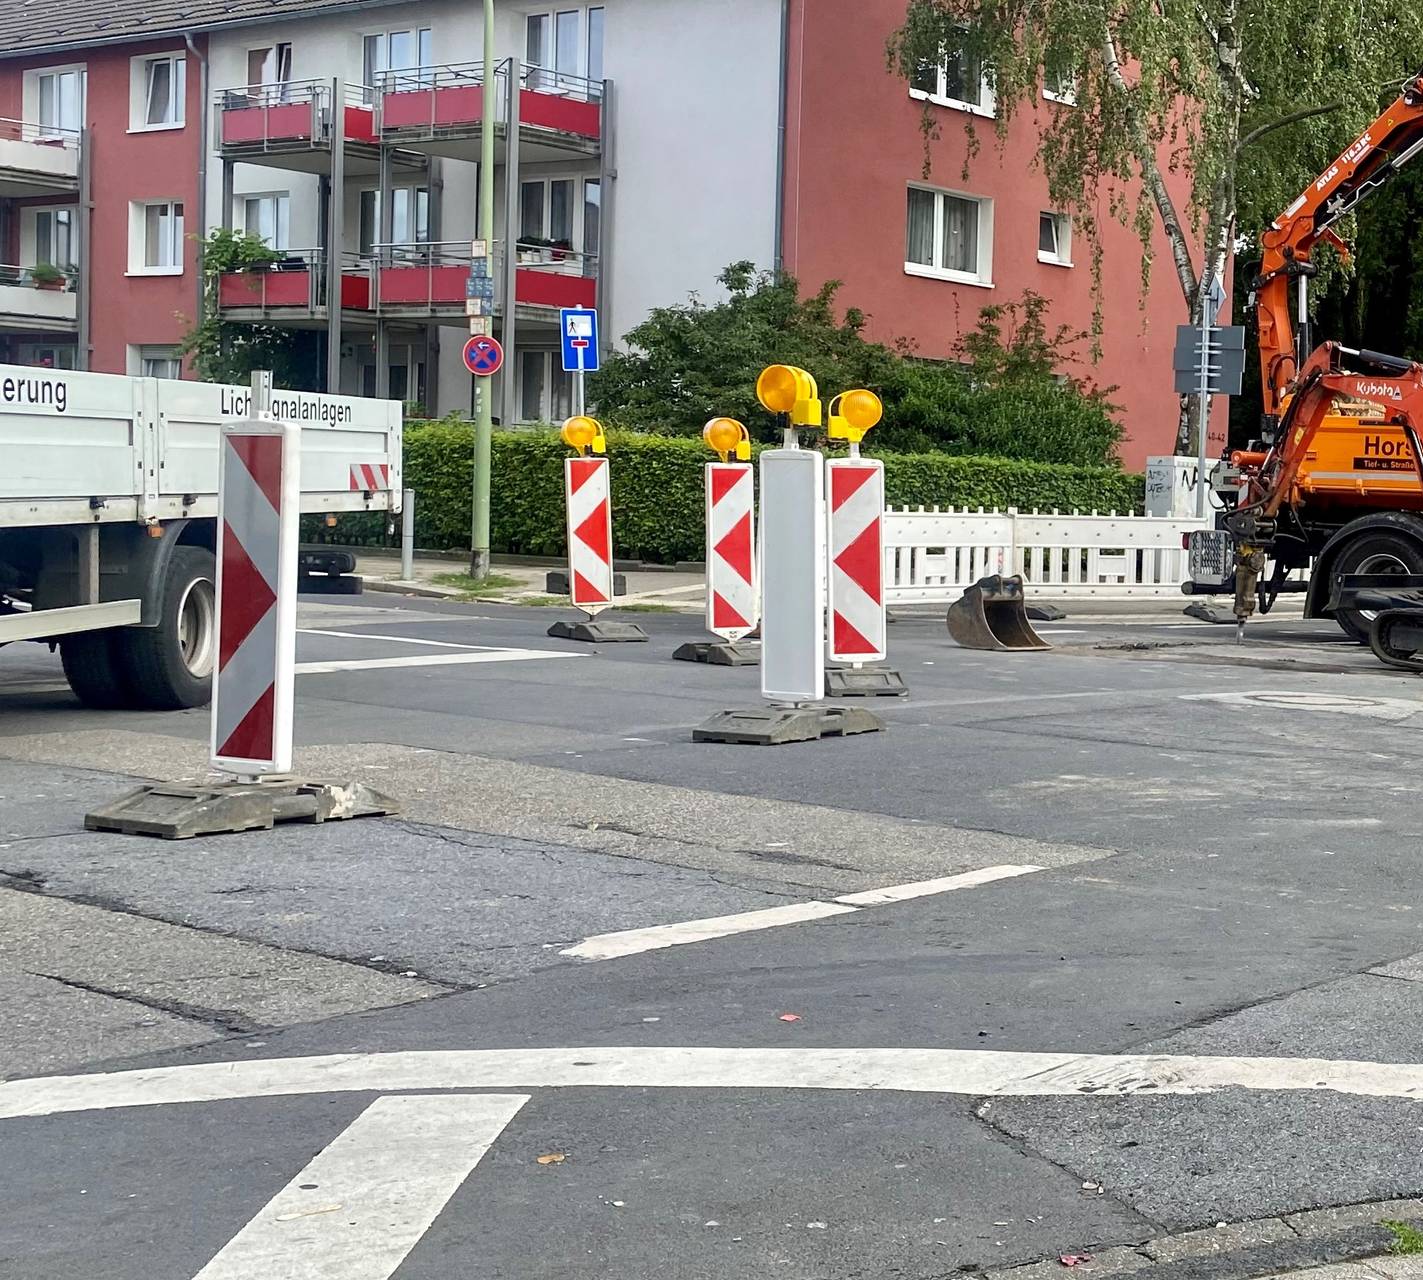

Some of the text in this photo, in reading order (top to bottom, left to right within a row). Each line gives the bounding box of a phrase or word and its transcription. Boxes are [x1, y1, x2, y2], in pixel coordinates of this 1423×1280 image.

[1316, 165, 1339, 191] ATLAS
[3, 377, 67, 412] erung
[1356, 381, 1395, 398] Kubota
[1390, 460, 1415, 470] Straße
